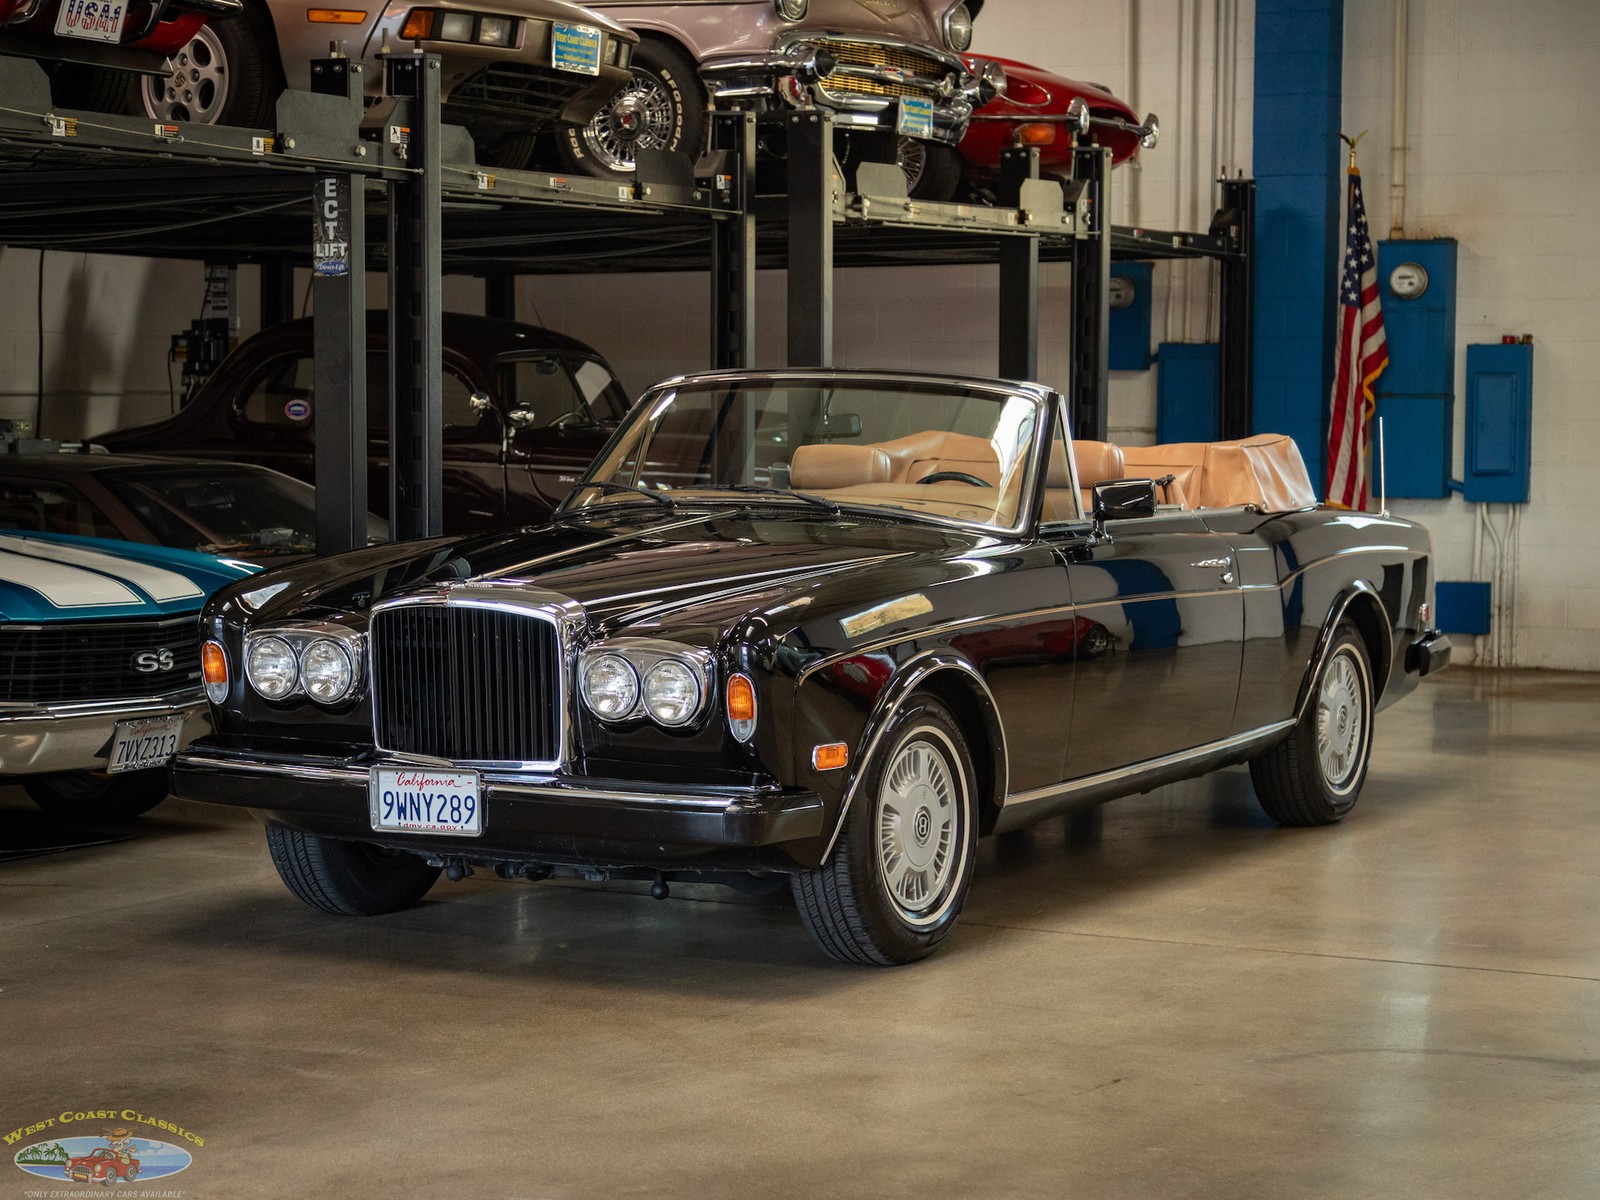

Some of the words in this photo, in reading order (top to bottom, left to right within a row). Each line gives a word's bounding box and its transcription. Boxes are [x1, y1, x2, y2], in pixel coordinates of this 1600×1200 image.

[316, 243, 348, 257] LIFT
[135, 648, 174, 672] SS
[129, 723, 170, 738] California
[117, 734, 176, 764] 7VXZ313
[397, 771, 462, 791] California
[383, 790, 476, 824] 9WNY289
